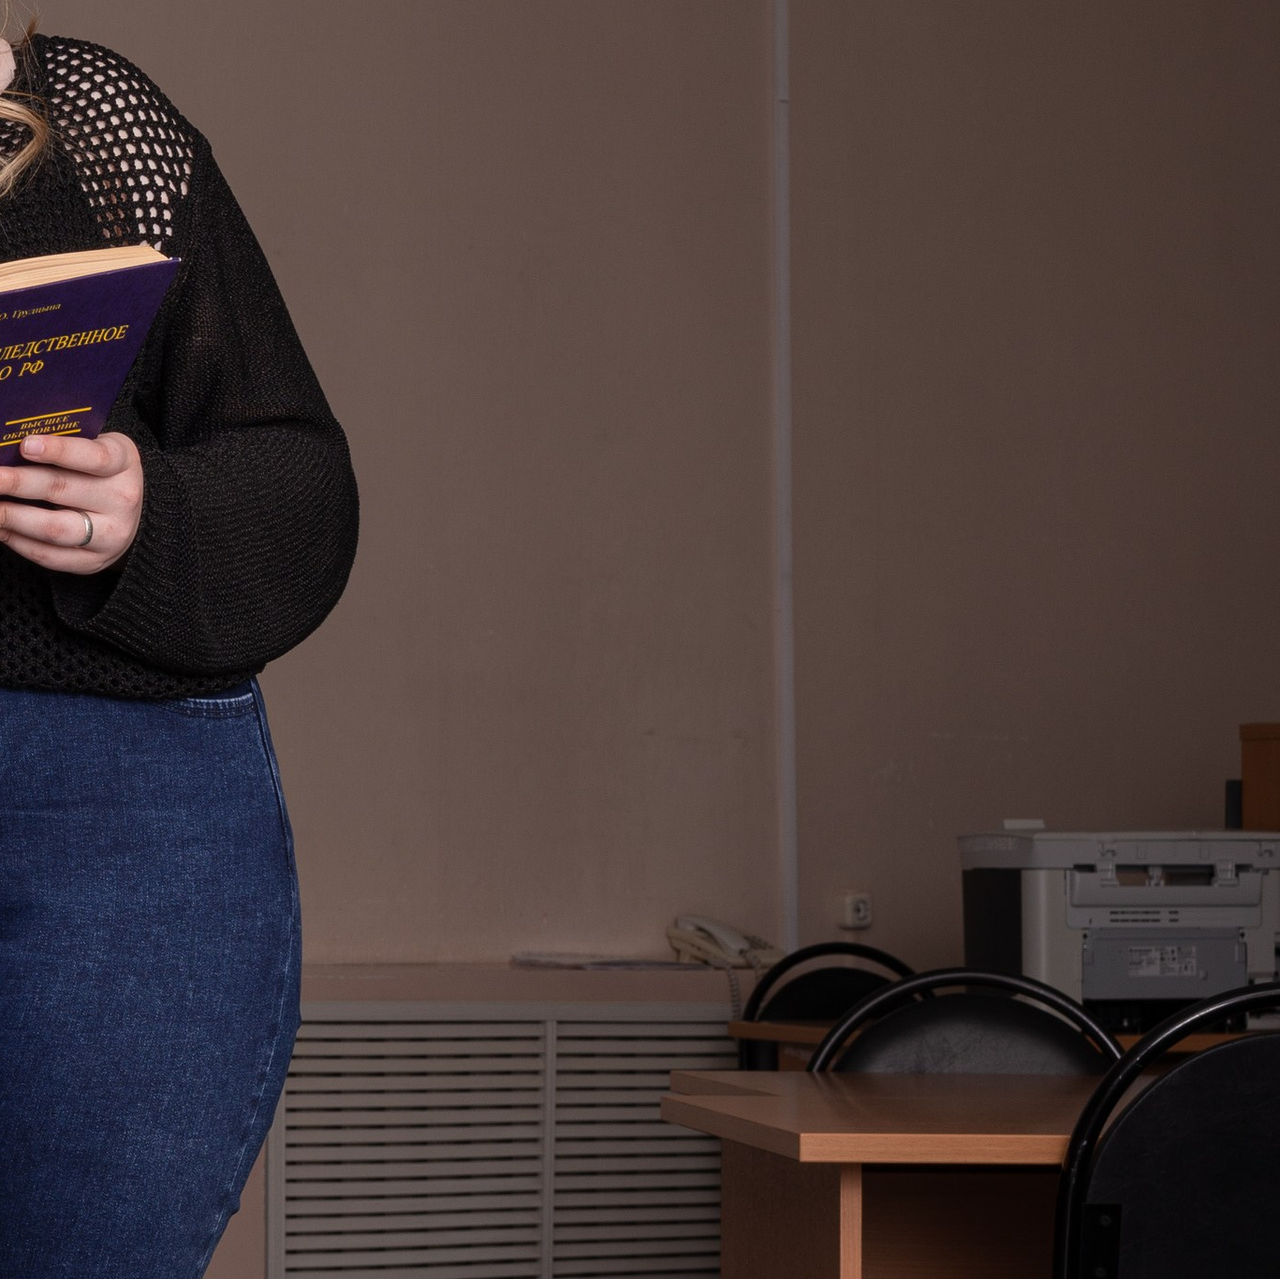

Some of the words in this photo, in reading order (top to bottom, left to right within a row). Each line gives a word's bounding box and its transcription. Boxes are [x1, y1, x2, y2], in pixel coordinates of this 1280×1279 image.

[17, 359, 45, 377] РФ
[2, 421, 80, 441] ОБРАЗОВАНИЕ
[19, 415, 70, 430] ВЫСШЕЕ
